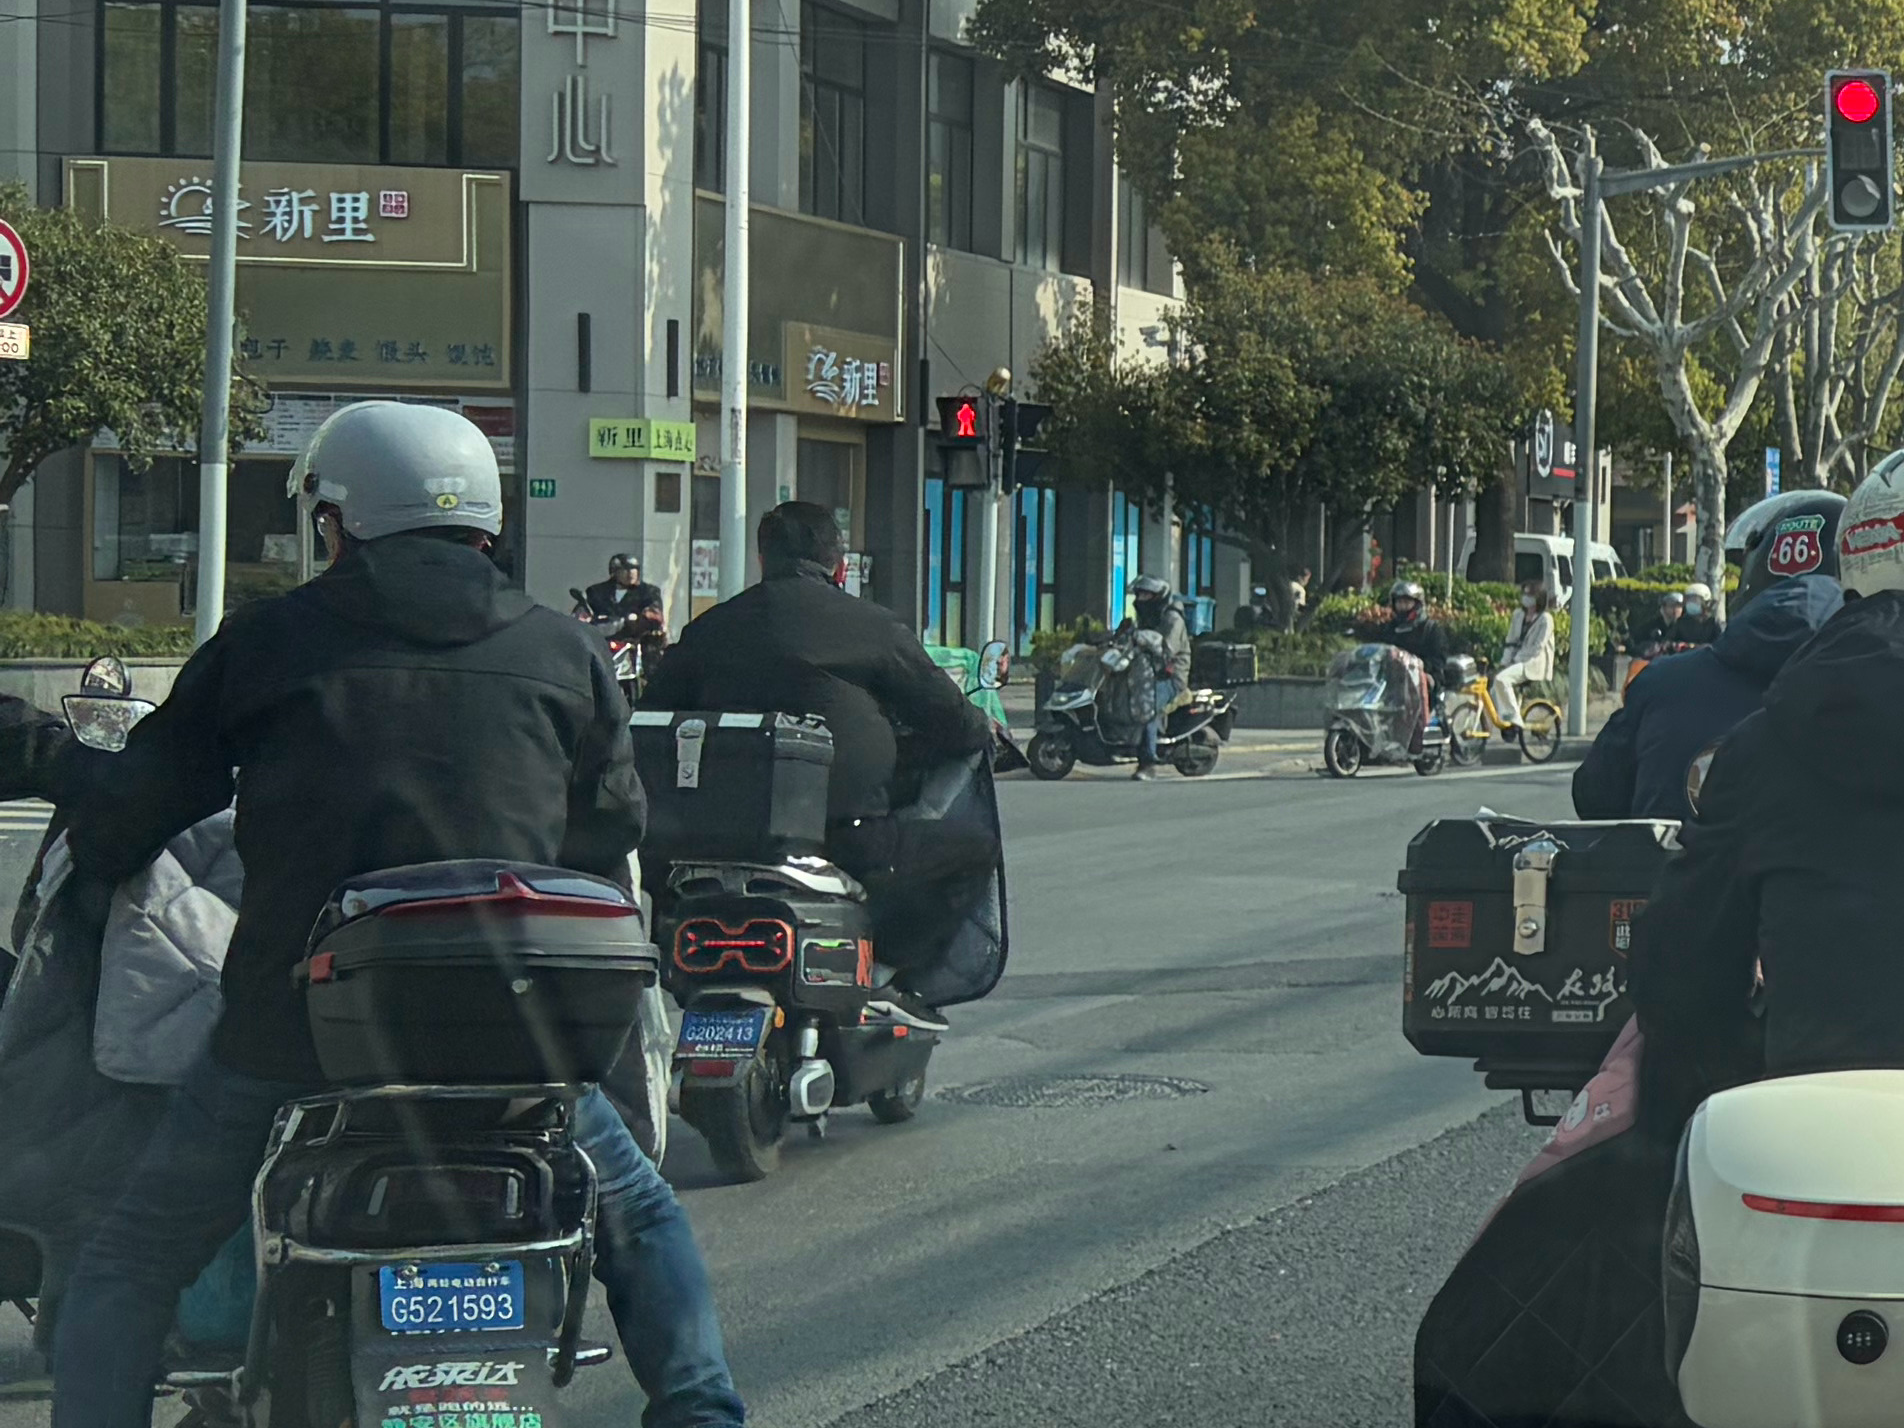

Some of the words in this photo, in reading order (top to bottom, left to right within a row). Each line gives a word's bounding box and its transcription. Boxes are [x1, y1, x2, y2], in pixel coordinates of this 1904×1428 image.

[259, 186, 377, 243] 新里
[842, 357, 880, 407] 新里
[597, 426, 645, 449] 新里
[1778, 519, 1819, 532] ROUTE
[1778, 535, 1809, 565] 66
[686, 1026, 755, 1042] G202413
[391, 1293, 514, 1323] G521593
